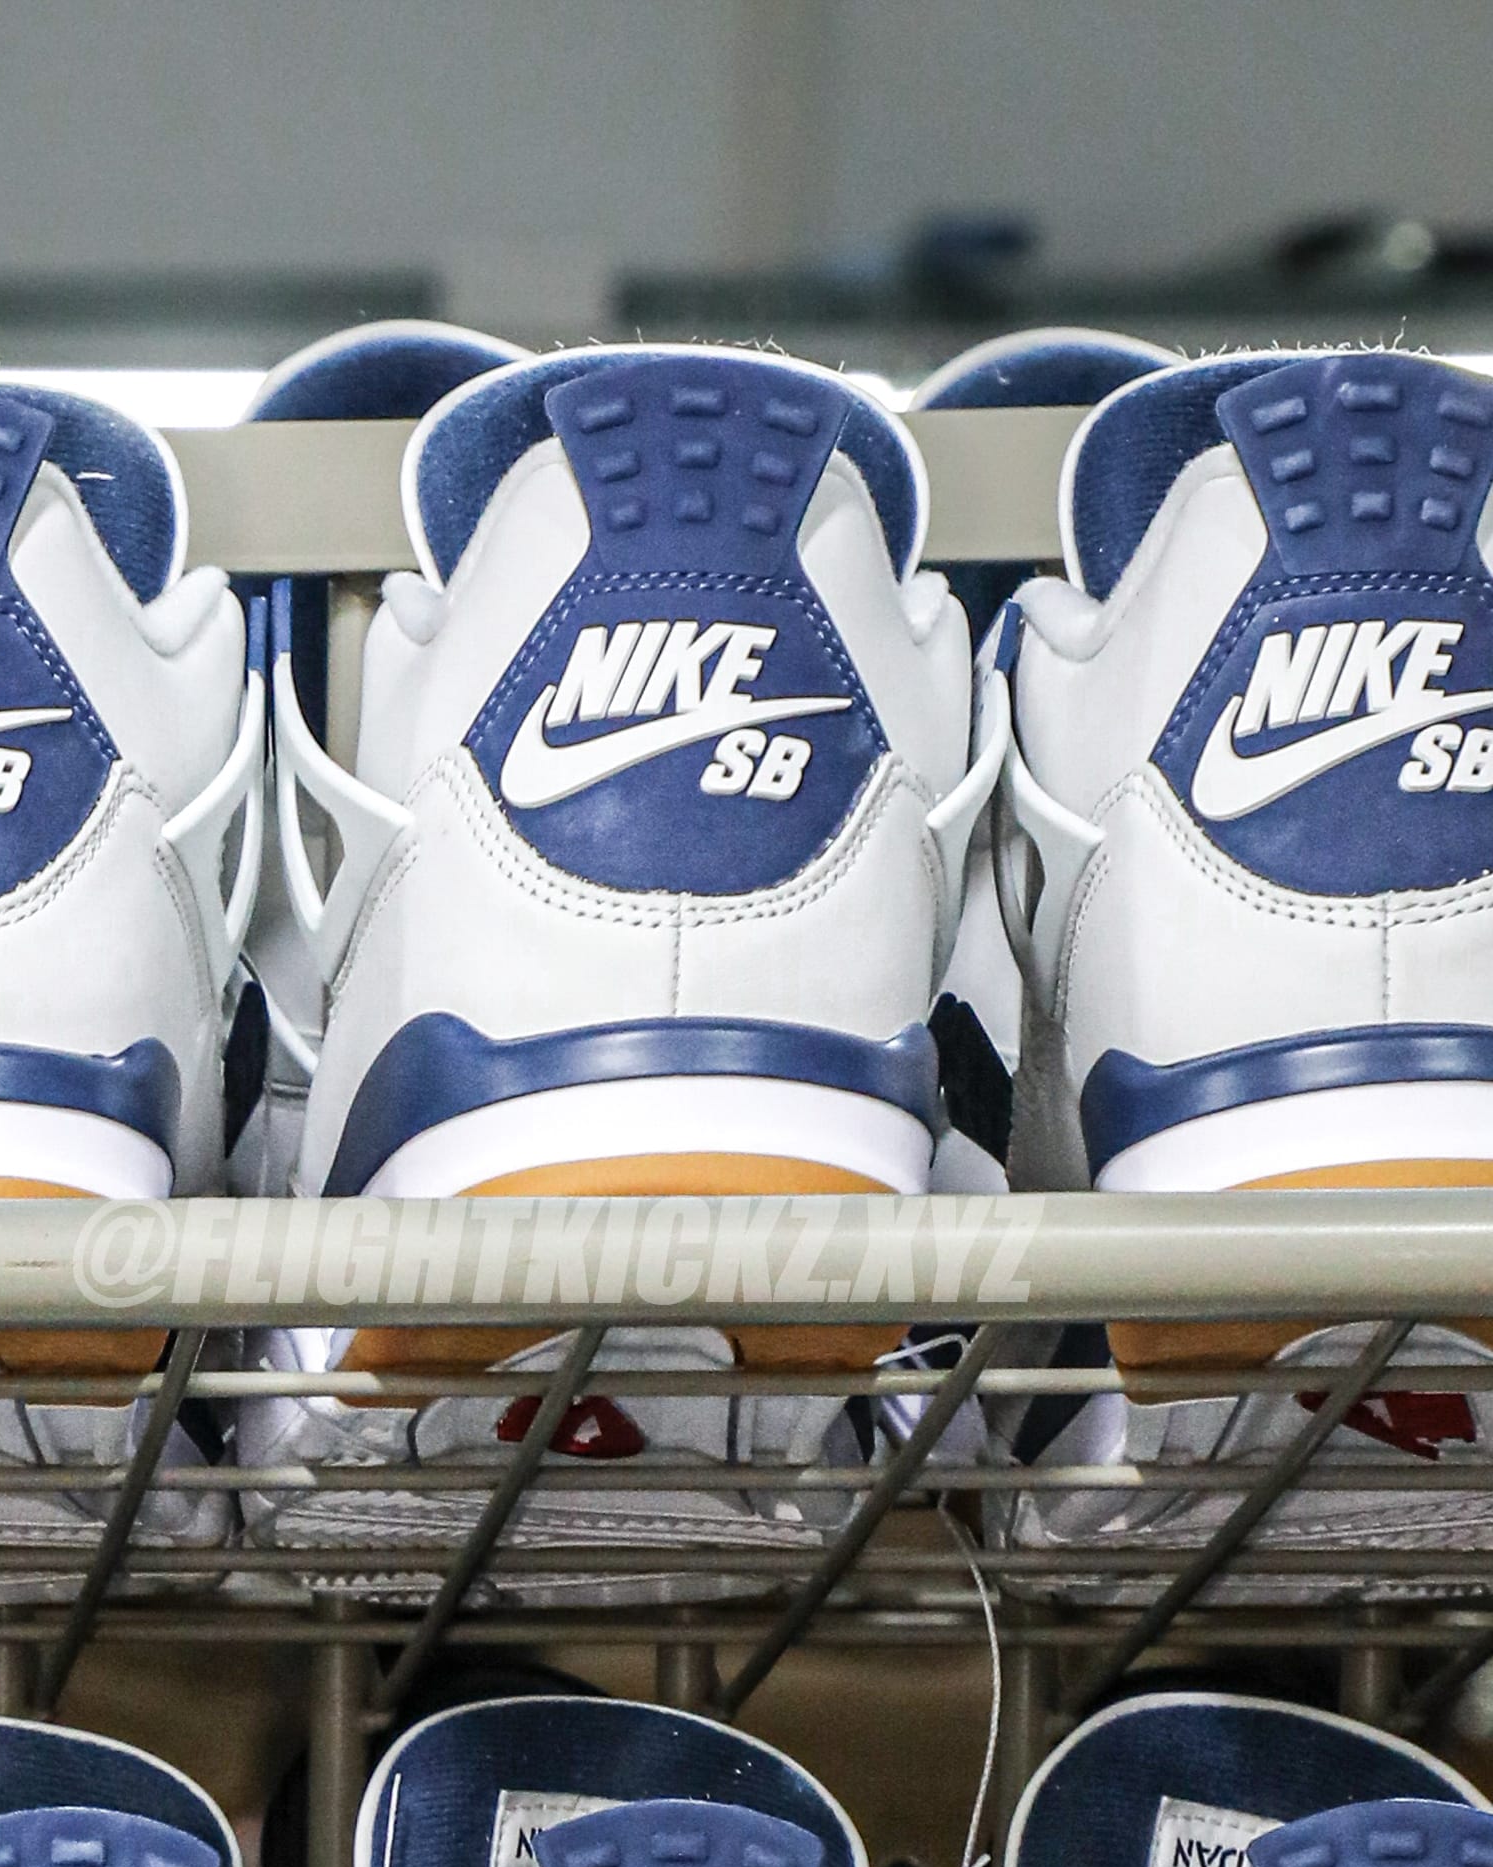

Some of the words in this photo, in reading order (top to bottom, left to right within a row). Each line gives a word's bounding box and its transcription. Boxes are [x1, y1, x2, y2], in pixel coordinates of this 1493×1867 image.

[544, 620, 776, 727] NIKE
[1235, 619, 1464, 734] NIKE
[697, 726, 813, 802] SB
[1395, 721, 1493, 794] SB
